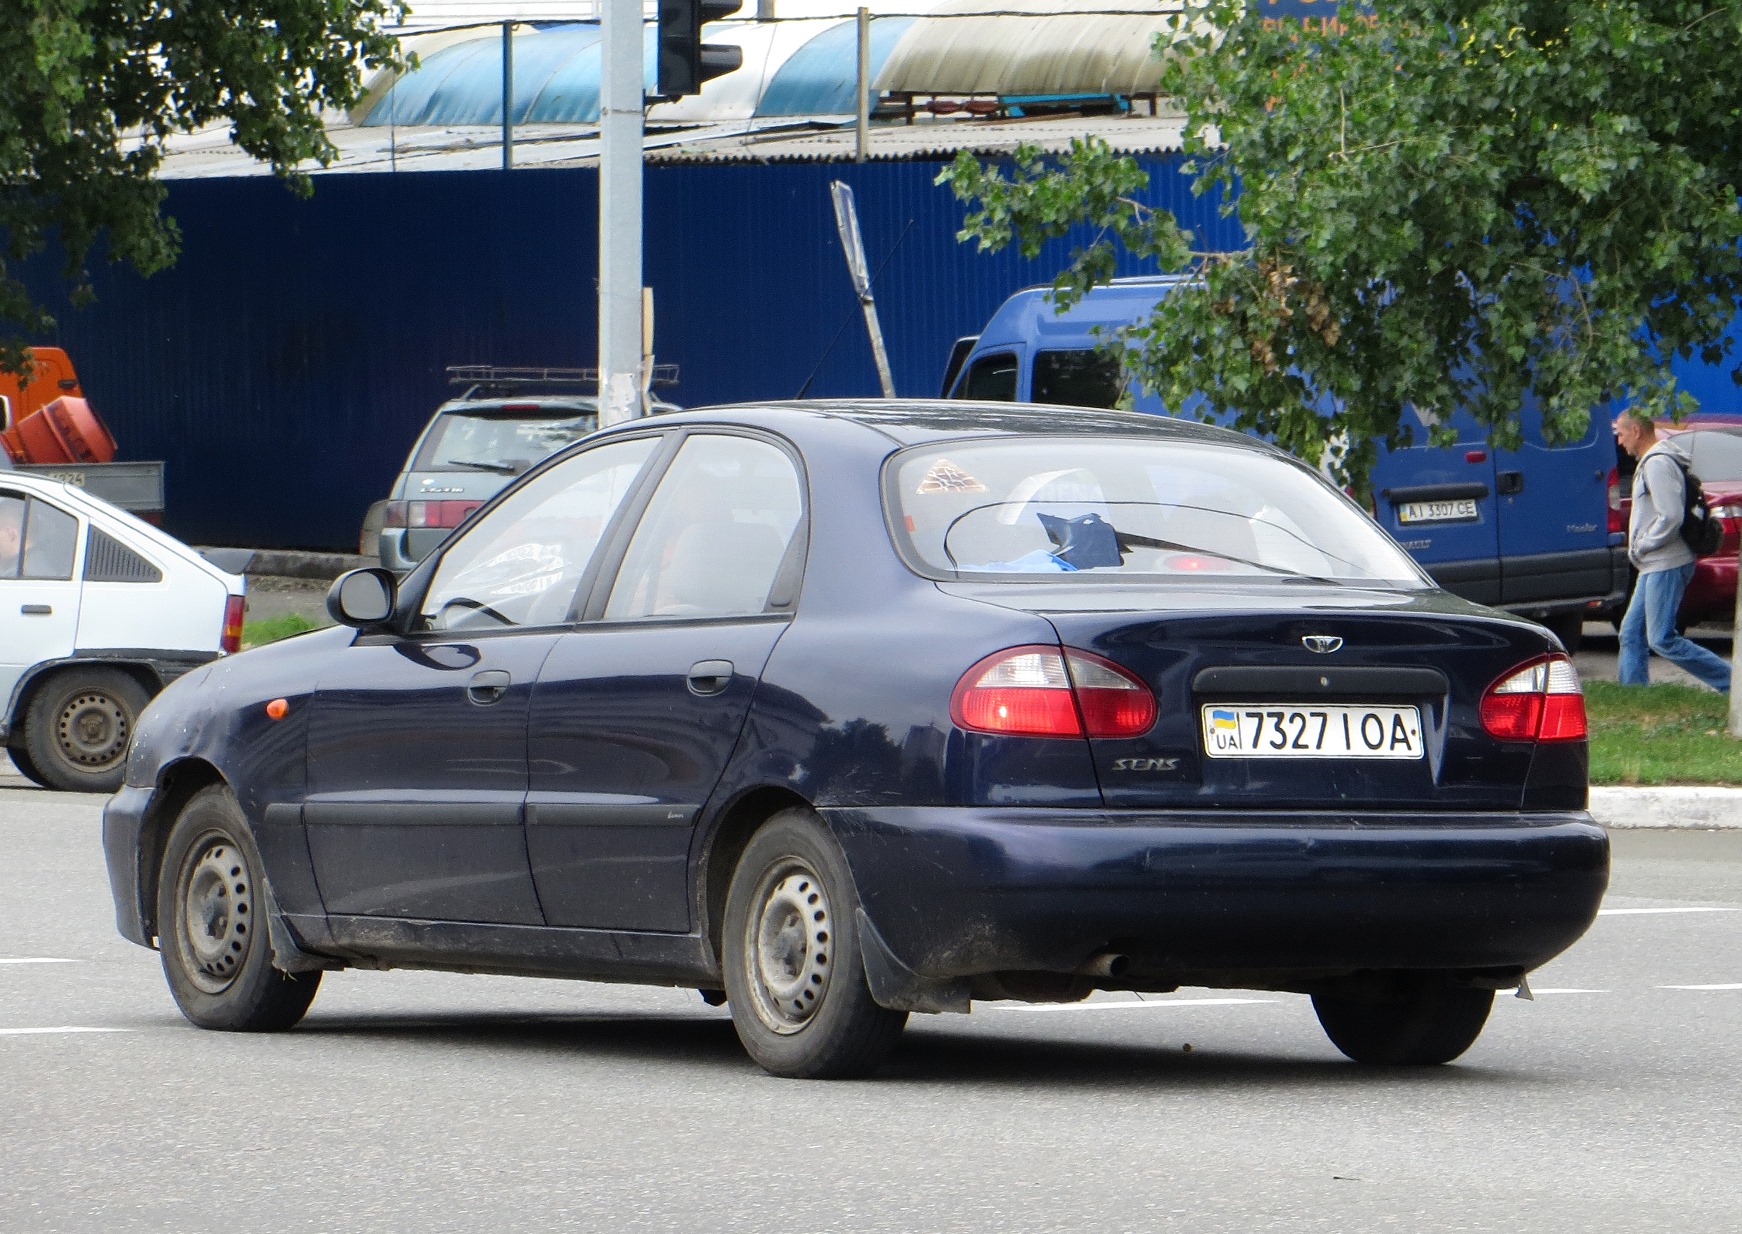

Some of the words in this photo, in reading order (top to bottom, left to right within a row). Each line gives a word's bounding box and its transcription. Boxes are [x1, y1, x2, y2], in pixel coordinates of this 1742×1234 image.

[1409, 505, 1423, 518] AI
[1428, 503, 1454, 517] 3307
[1457, 501, 1474, 515] CE
[1216, 734, 1239, 750] UA
[1111, 758, 1180, 771] SENS
